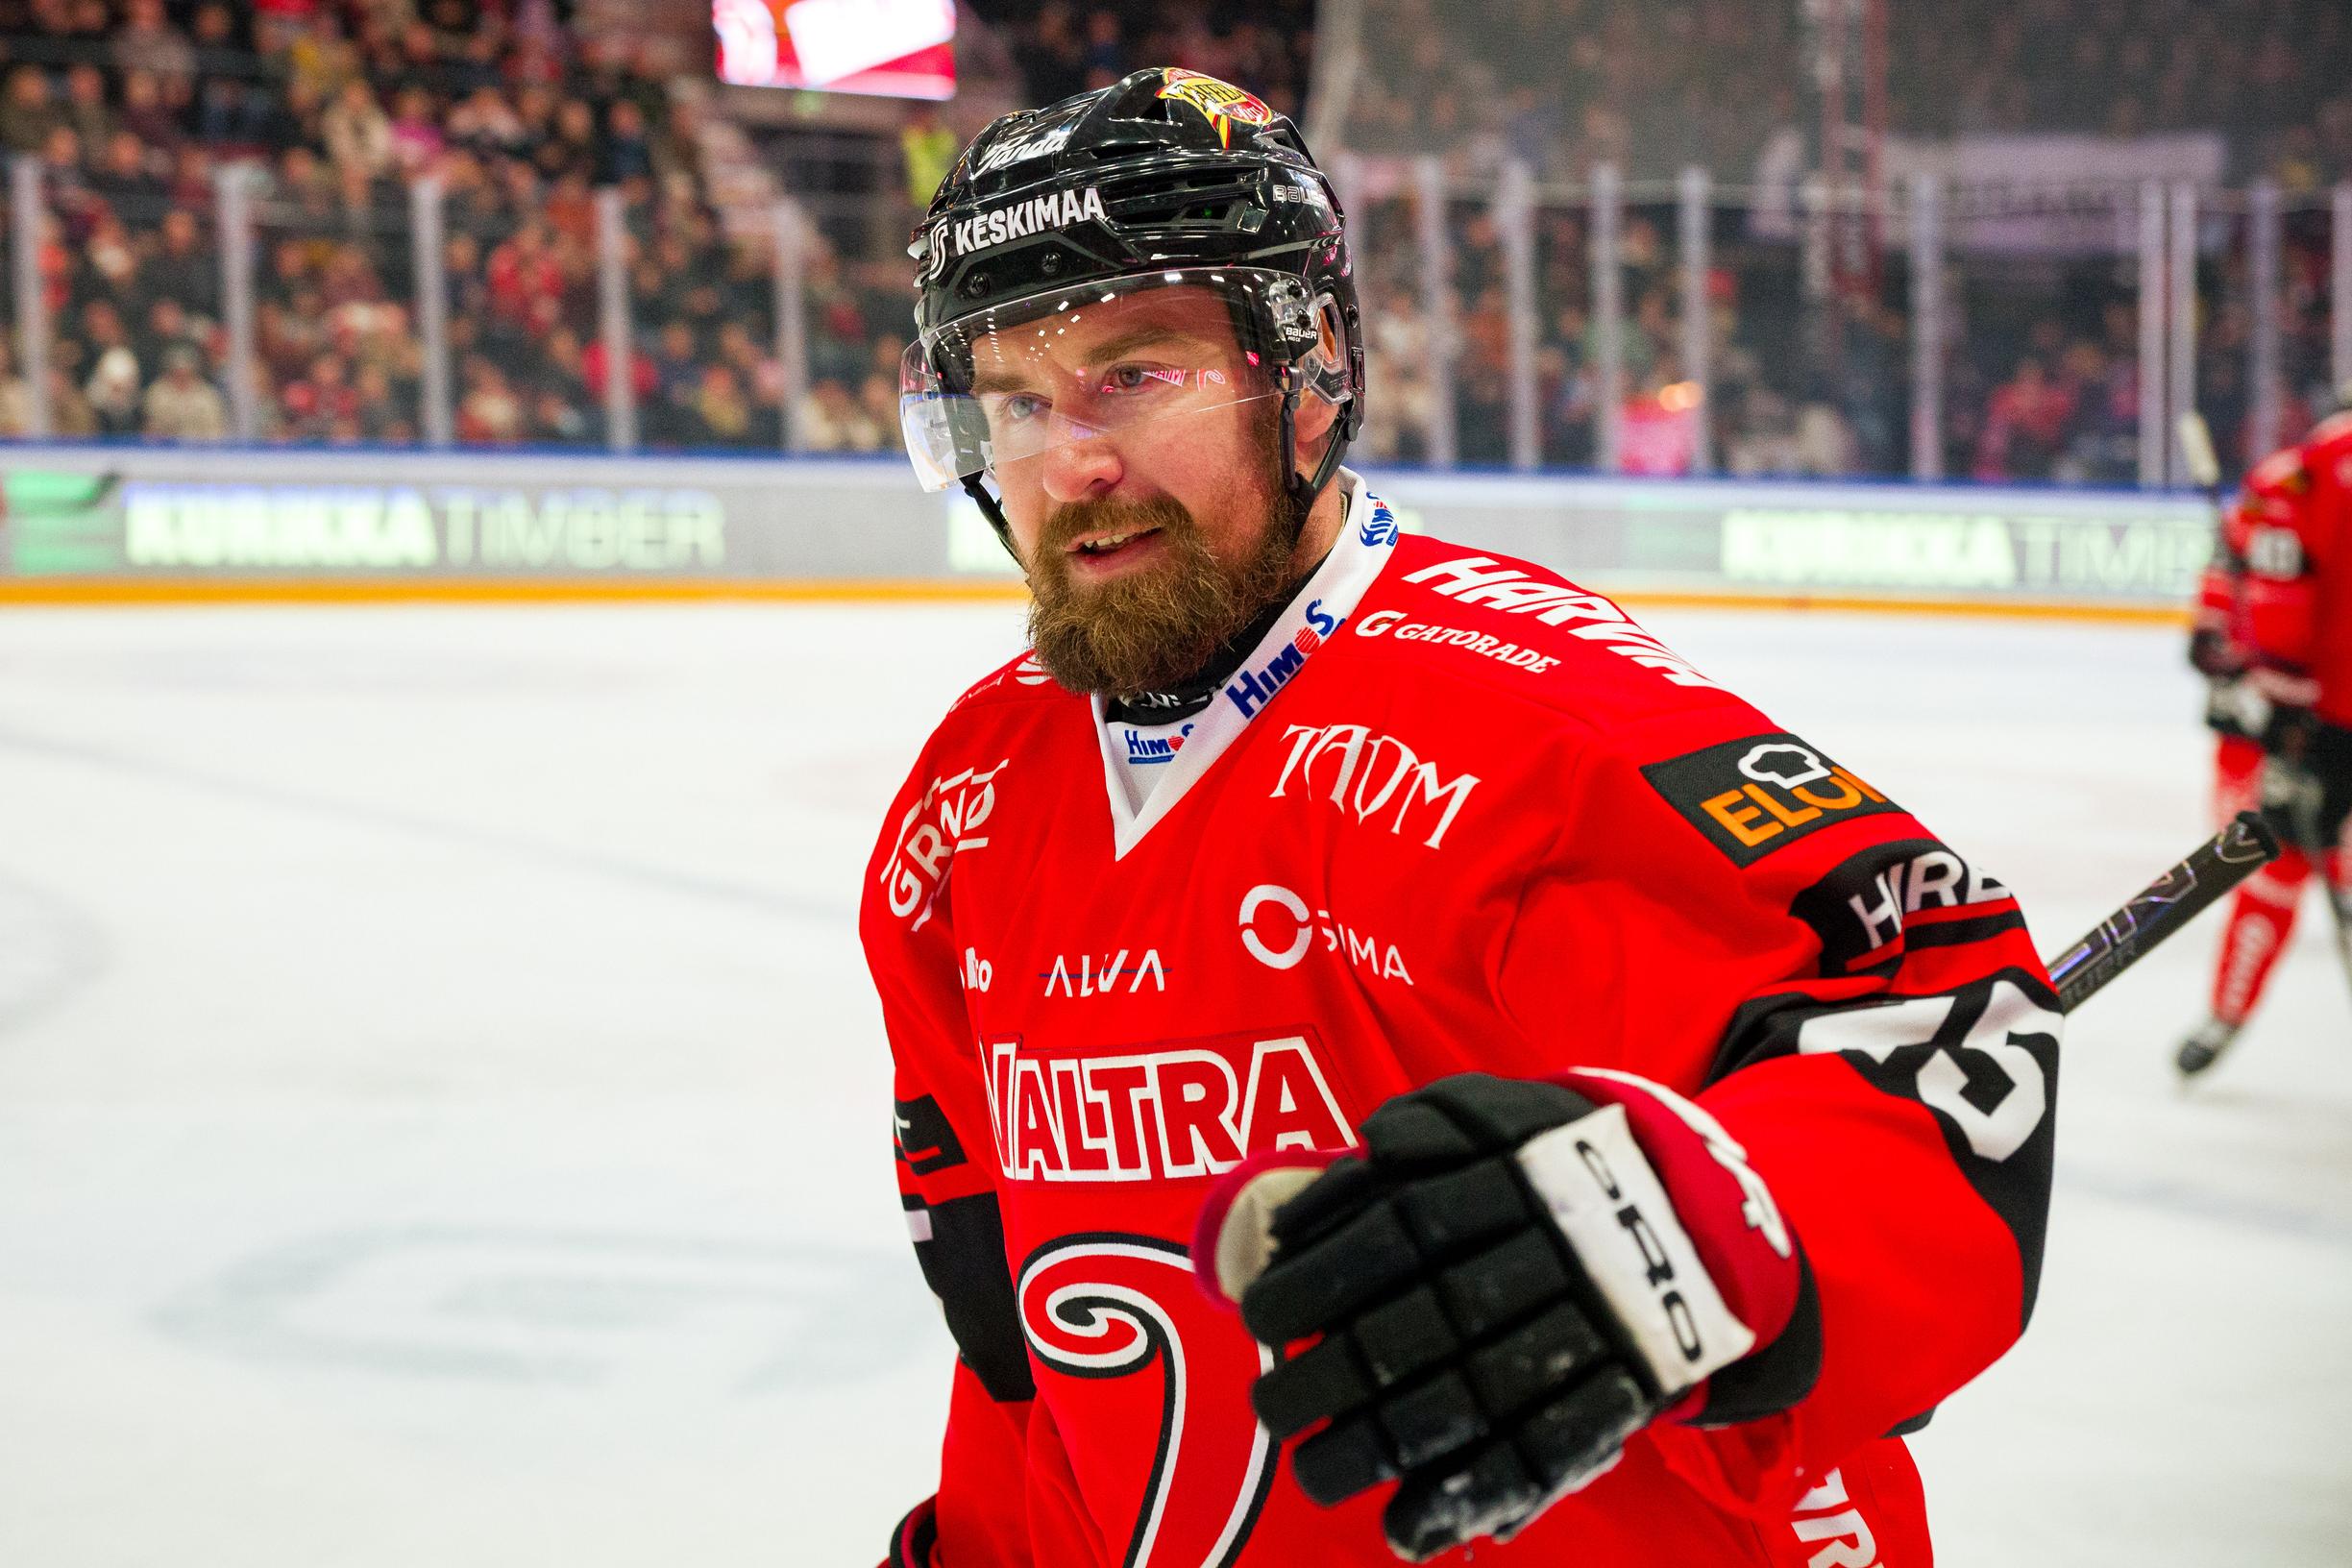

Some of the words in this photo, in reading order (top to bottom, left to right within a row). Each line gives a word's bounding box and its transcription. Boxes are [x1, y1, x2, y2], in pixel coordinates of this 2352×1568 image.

[956, 188, 1107, 256] KESKIMAA
[1394, 623, 1561, 674] GATORADE
[980, 1036, 1360, 1182] VALTRA
